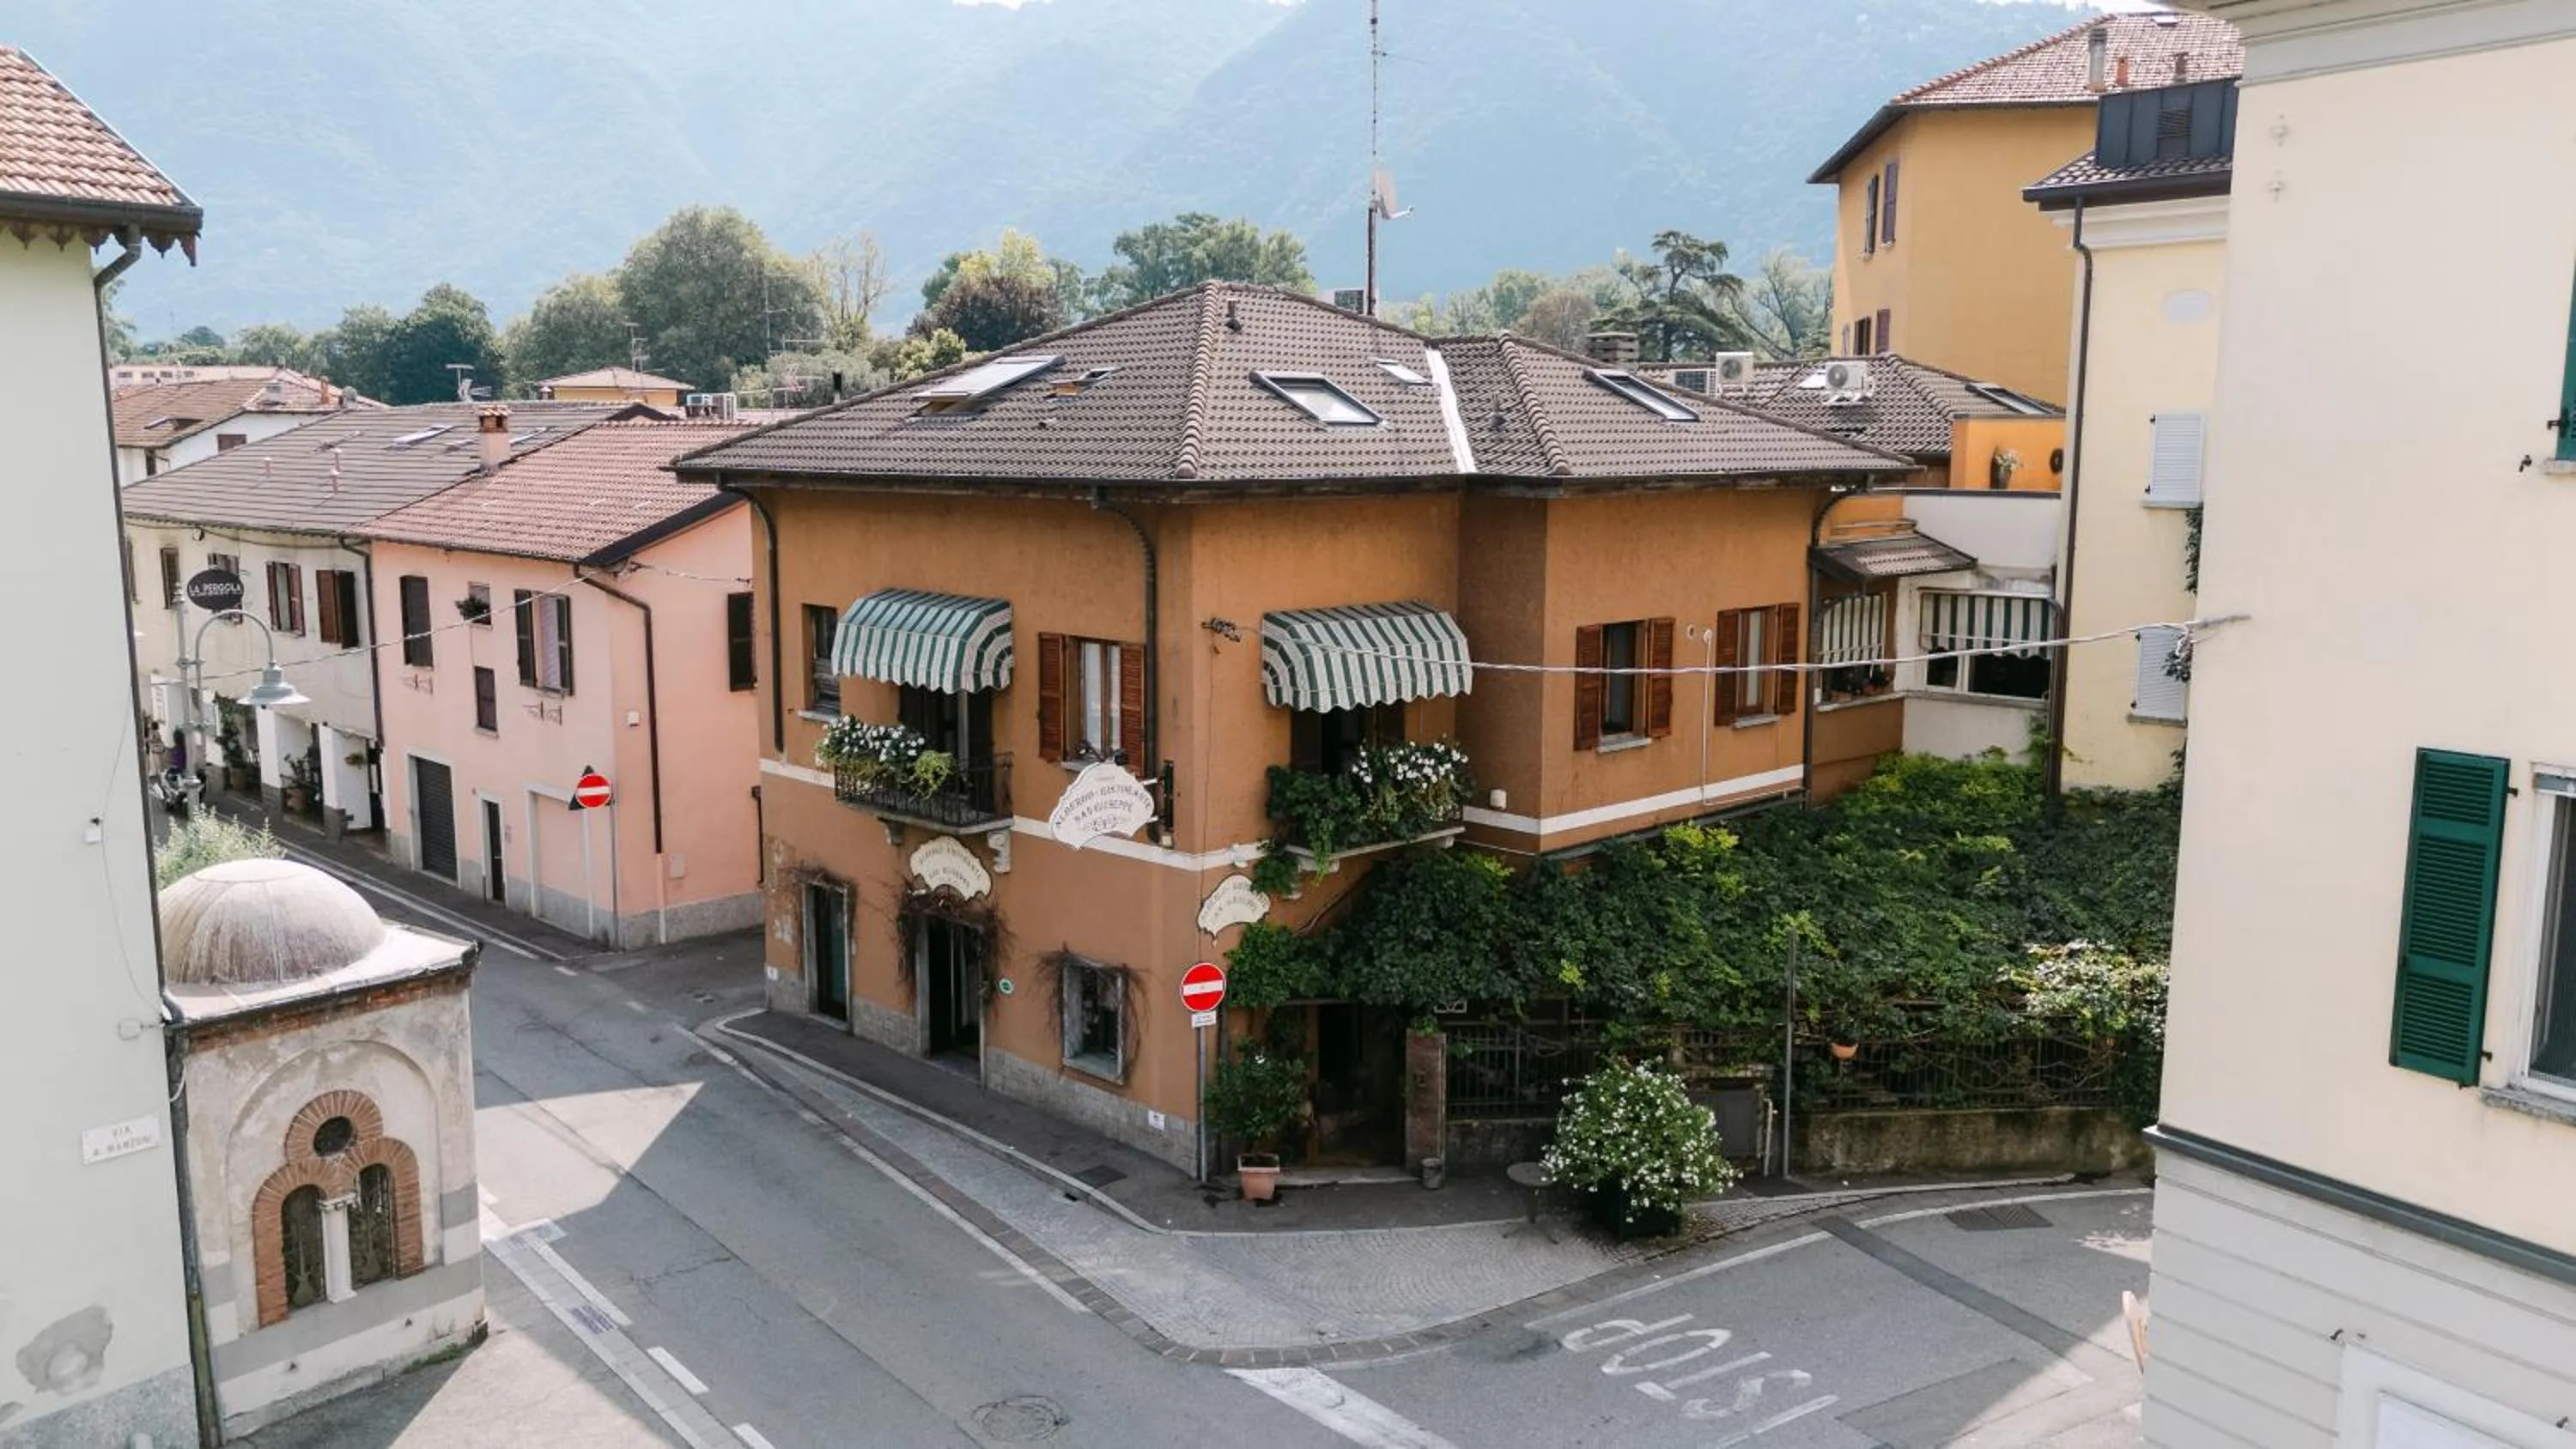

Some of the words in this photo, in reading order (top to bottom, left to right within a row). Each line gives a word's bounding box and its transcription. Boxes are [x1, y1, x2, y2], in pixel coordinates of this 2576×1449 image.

[188, 583, 199, 593] LA
[204, 582, 241, 592] PERGOLA
[112, 1125, 134, 1137] VIA
[1561, 1313, 1812, 1418] STOP
